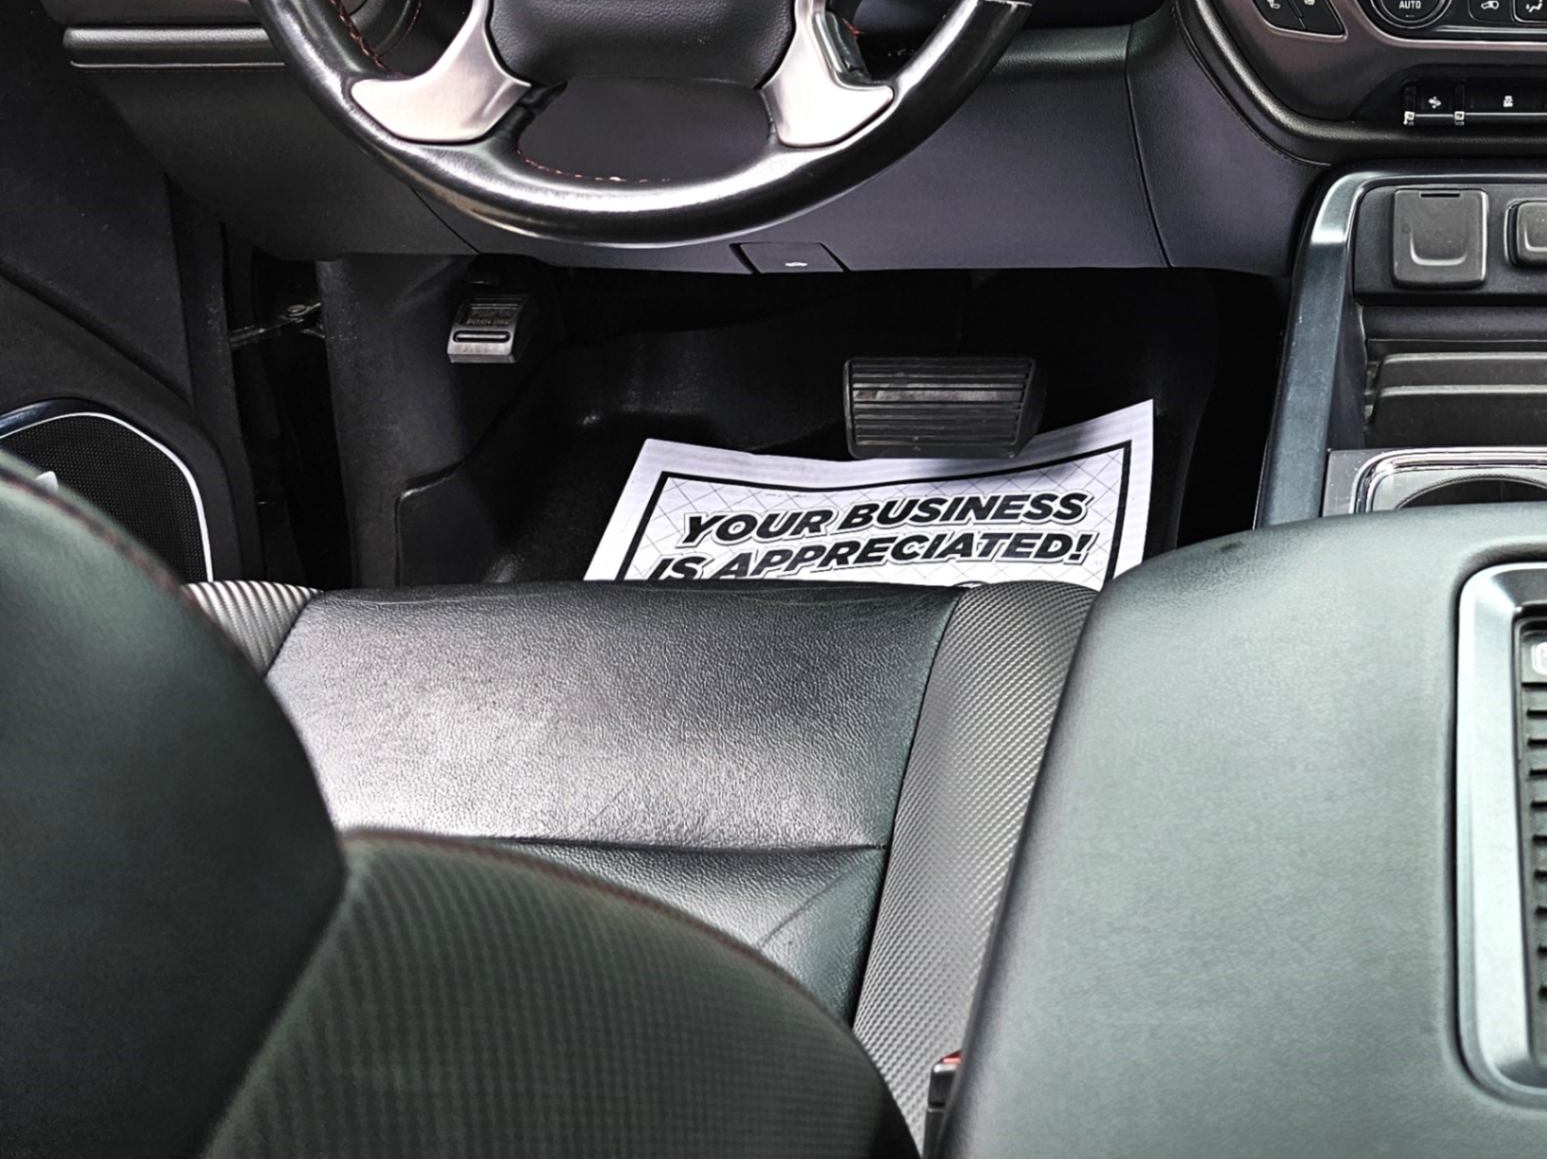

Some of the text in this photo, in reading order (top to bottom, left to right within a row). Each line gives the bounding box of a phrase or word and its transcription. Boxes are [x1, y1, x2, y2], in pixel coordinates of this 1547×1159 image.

[1398, 0, 1422, 10] AUTO
[681, 492, 1092, 544] YOUR BUSINESS
[646, 532, 1092, 581] IS APPRECIATED!
